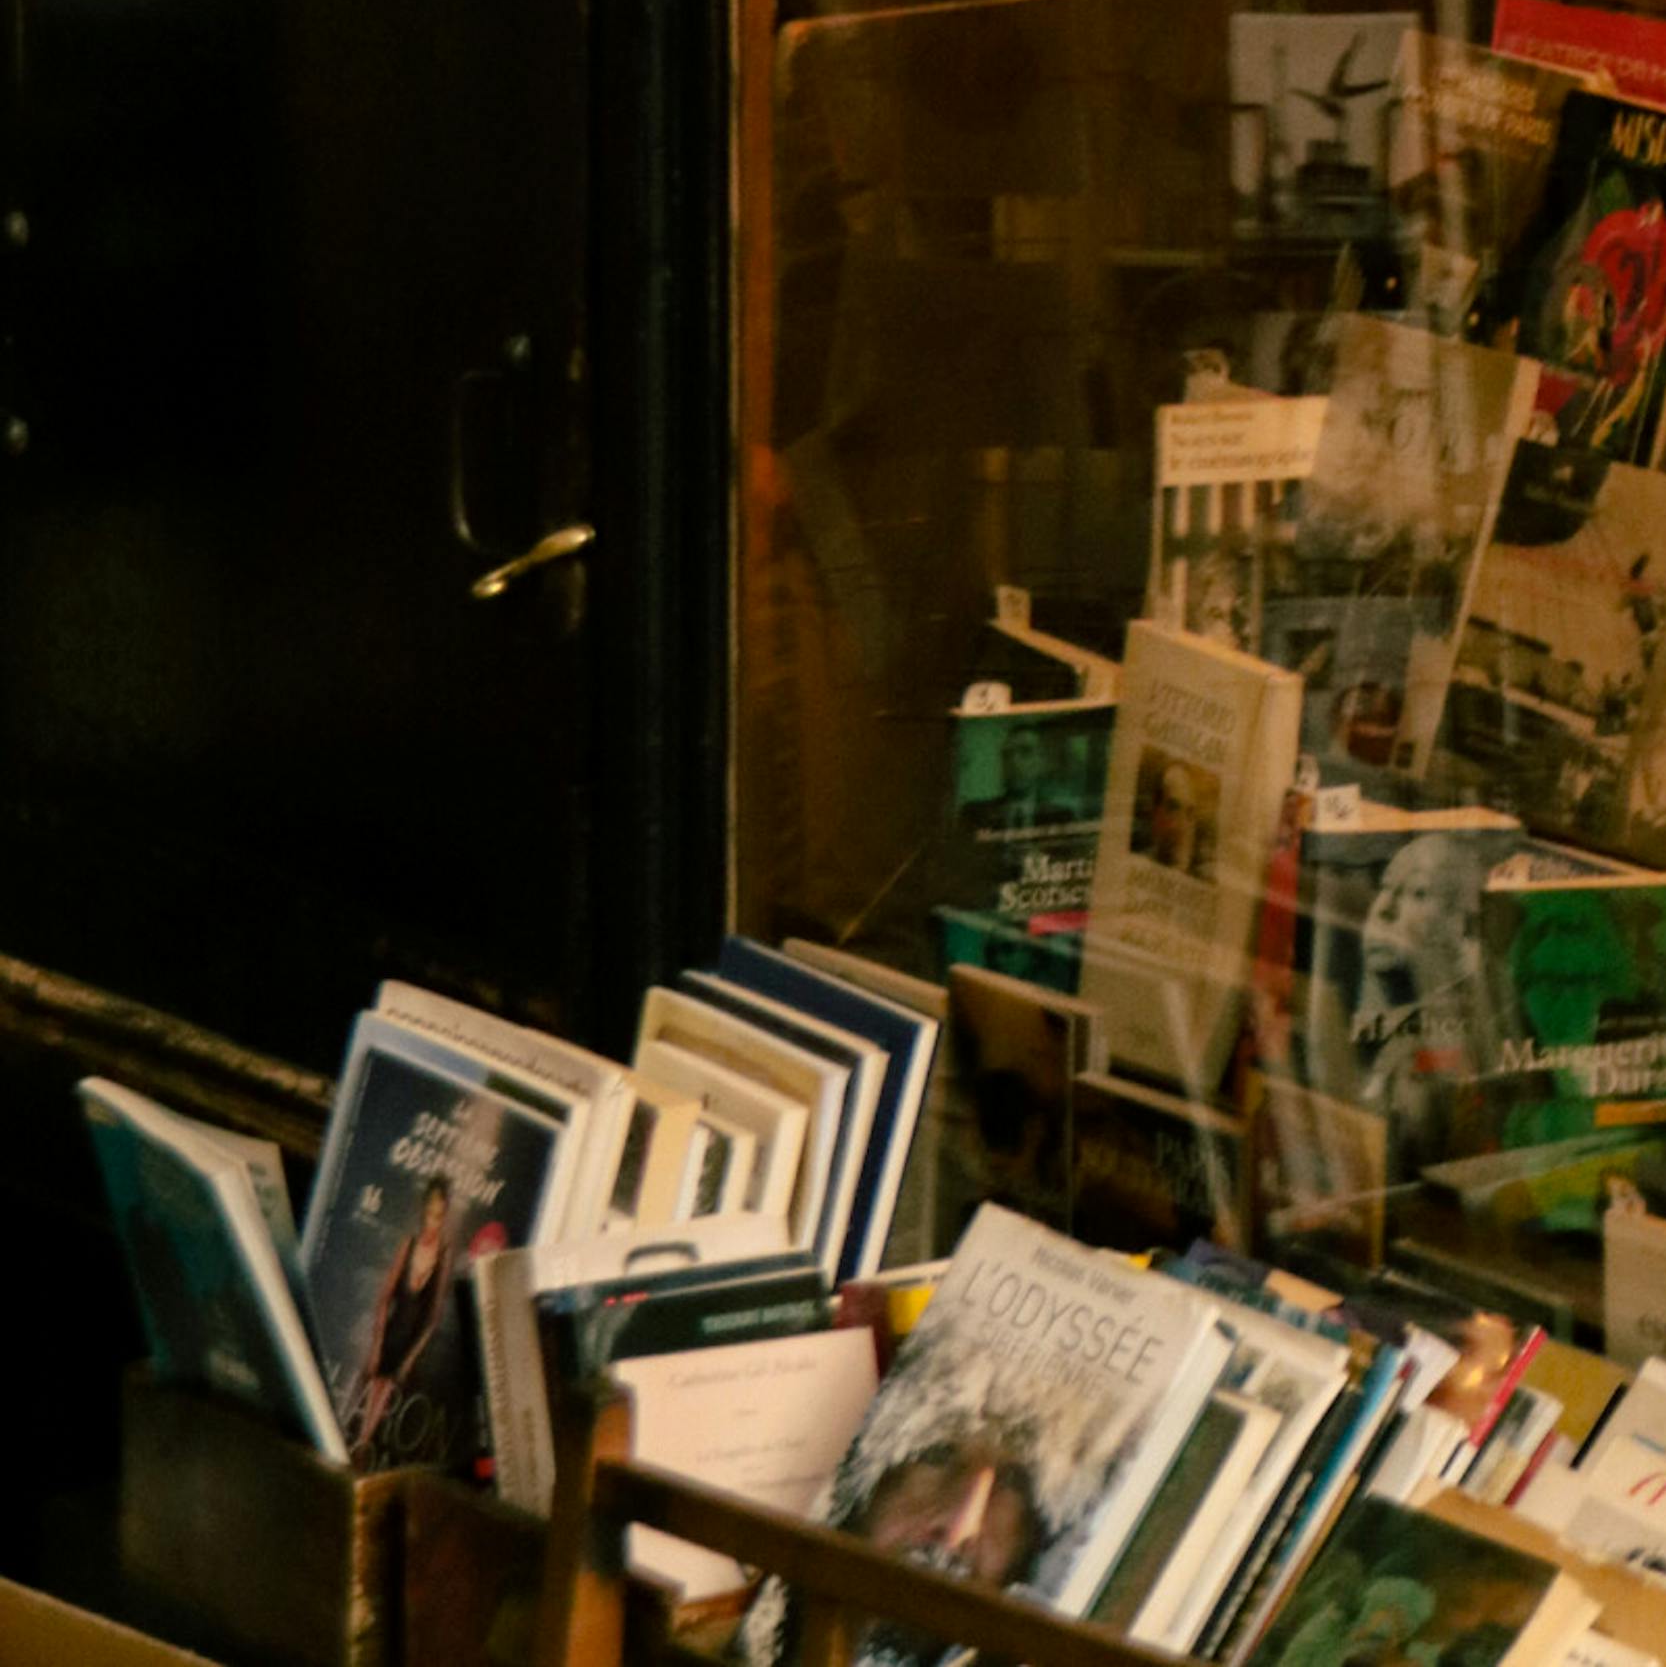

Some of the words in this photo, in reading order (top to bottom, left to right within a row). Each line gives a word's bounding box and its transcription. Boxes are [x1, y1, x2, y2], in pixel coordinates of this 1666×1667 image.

[1020, 850, 1097, 885] Marti
[997, 880, 1091, 916] Scorse
[959, 1257, 1165, 1385] L'ODYSSÉE
